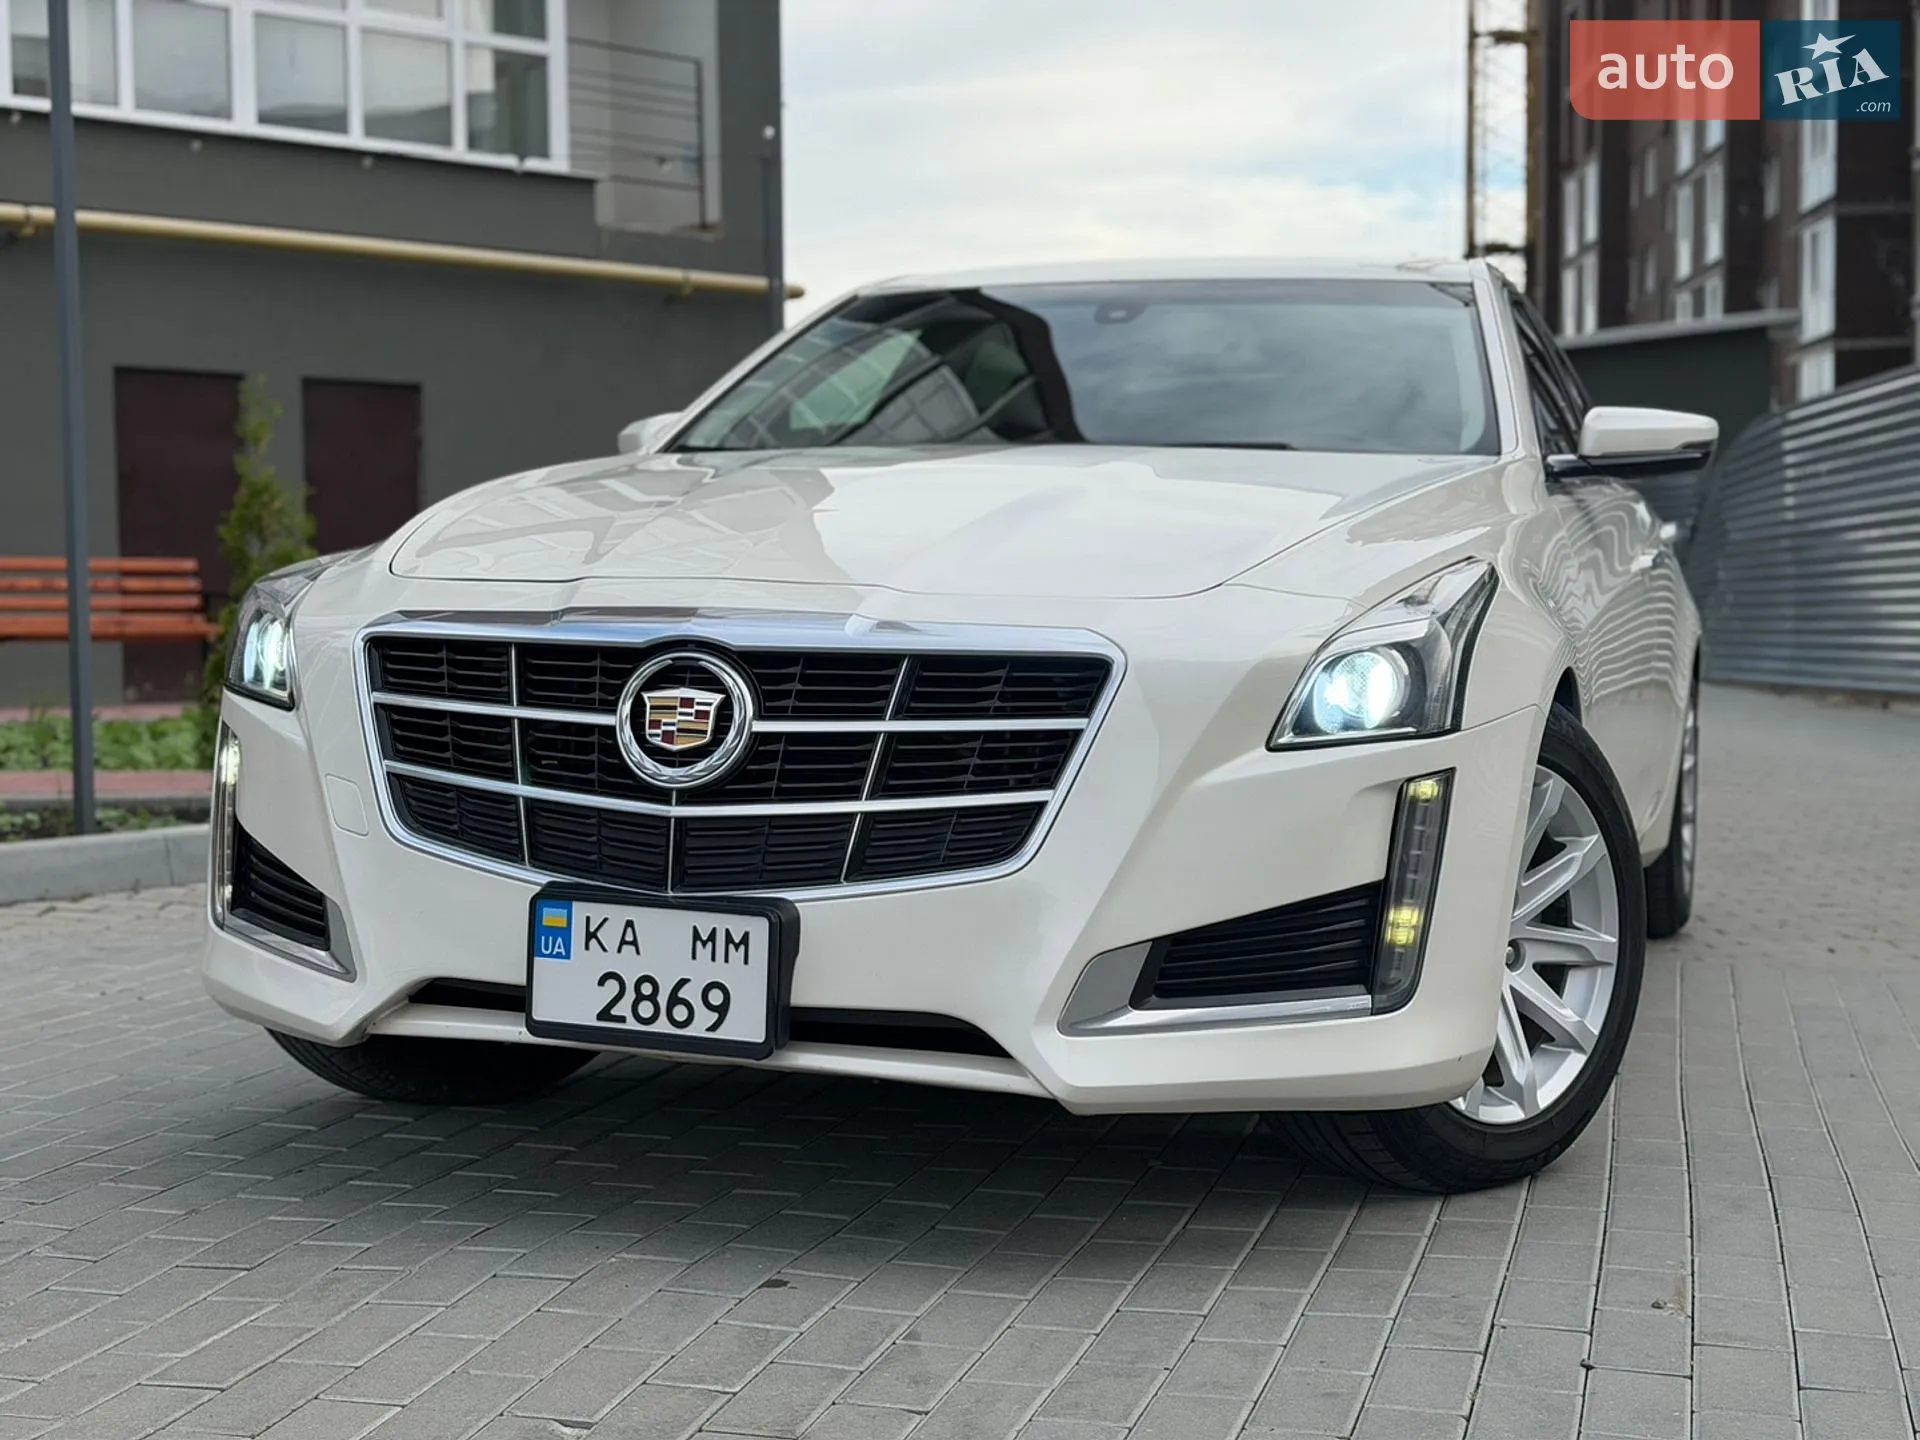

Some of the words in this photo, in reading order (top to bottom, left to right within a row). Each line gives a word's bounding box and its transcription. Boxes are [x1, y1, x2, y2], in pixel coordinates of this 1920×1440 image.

[541, 935, 566, 956] UA
[584, 915, 641, 956] KA
[691, 924, 750, 966] MM
[596, 971, 731, 1032] 2869
